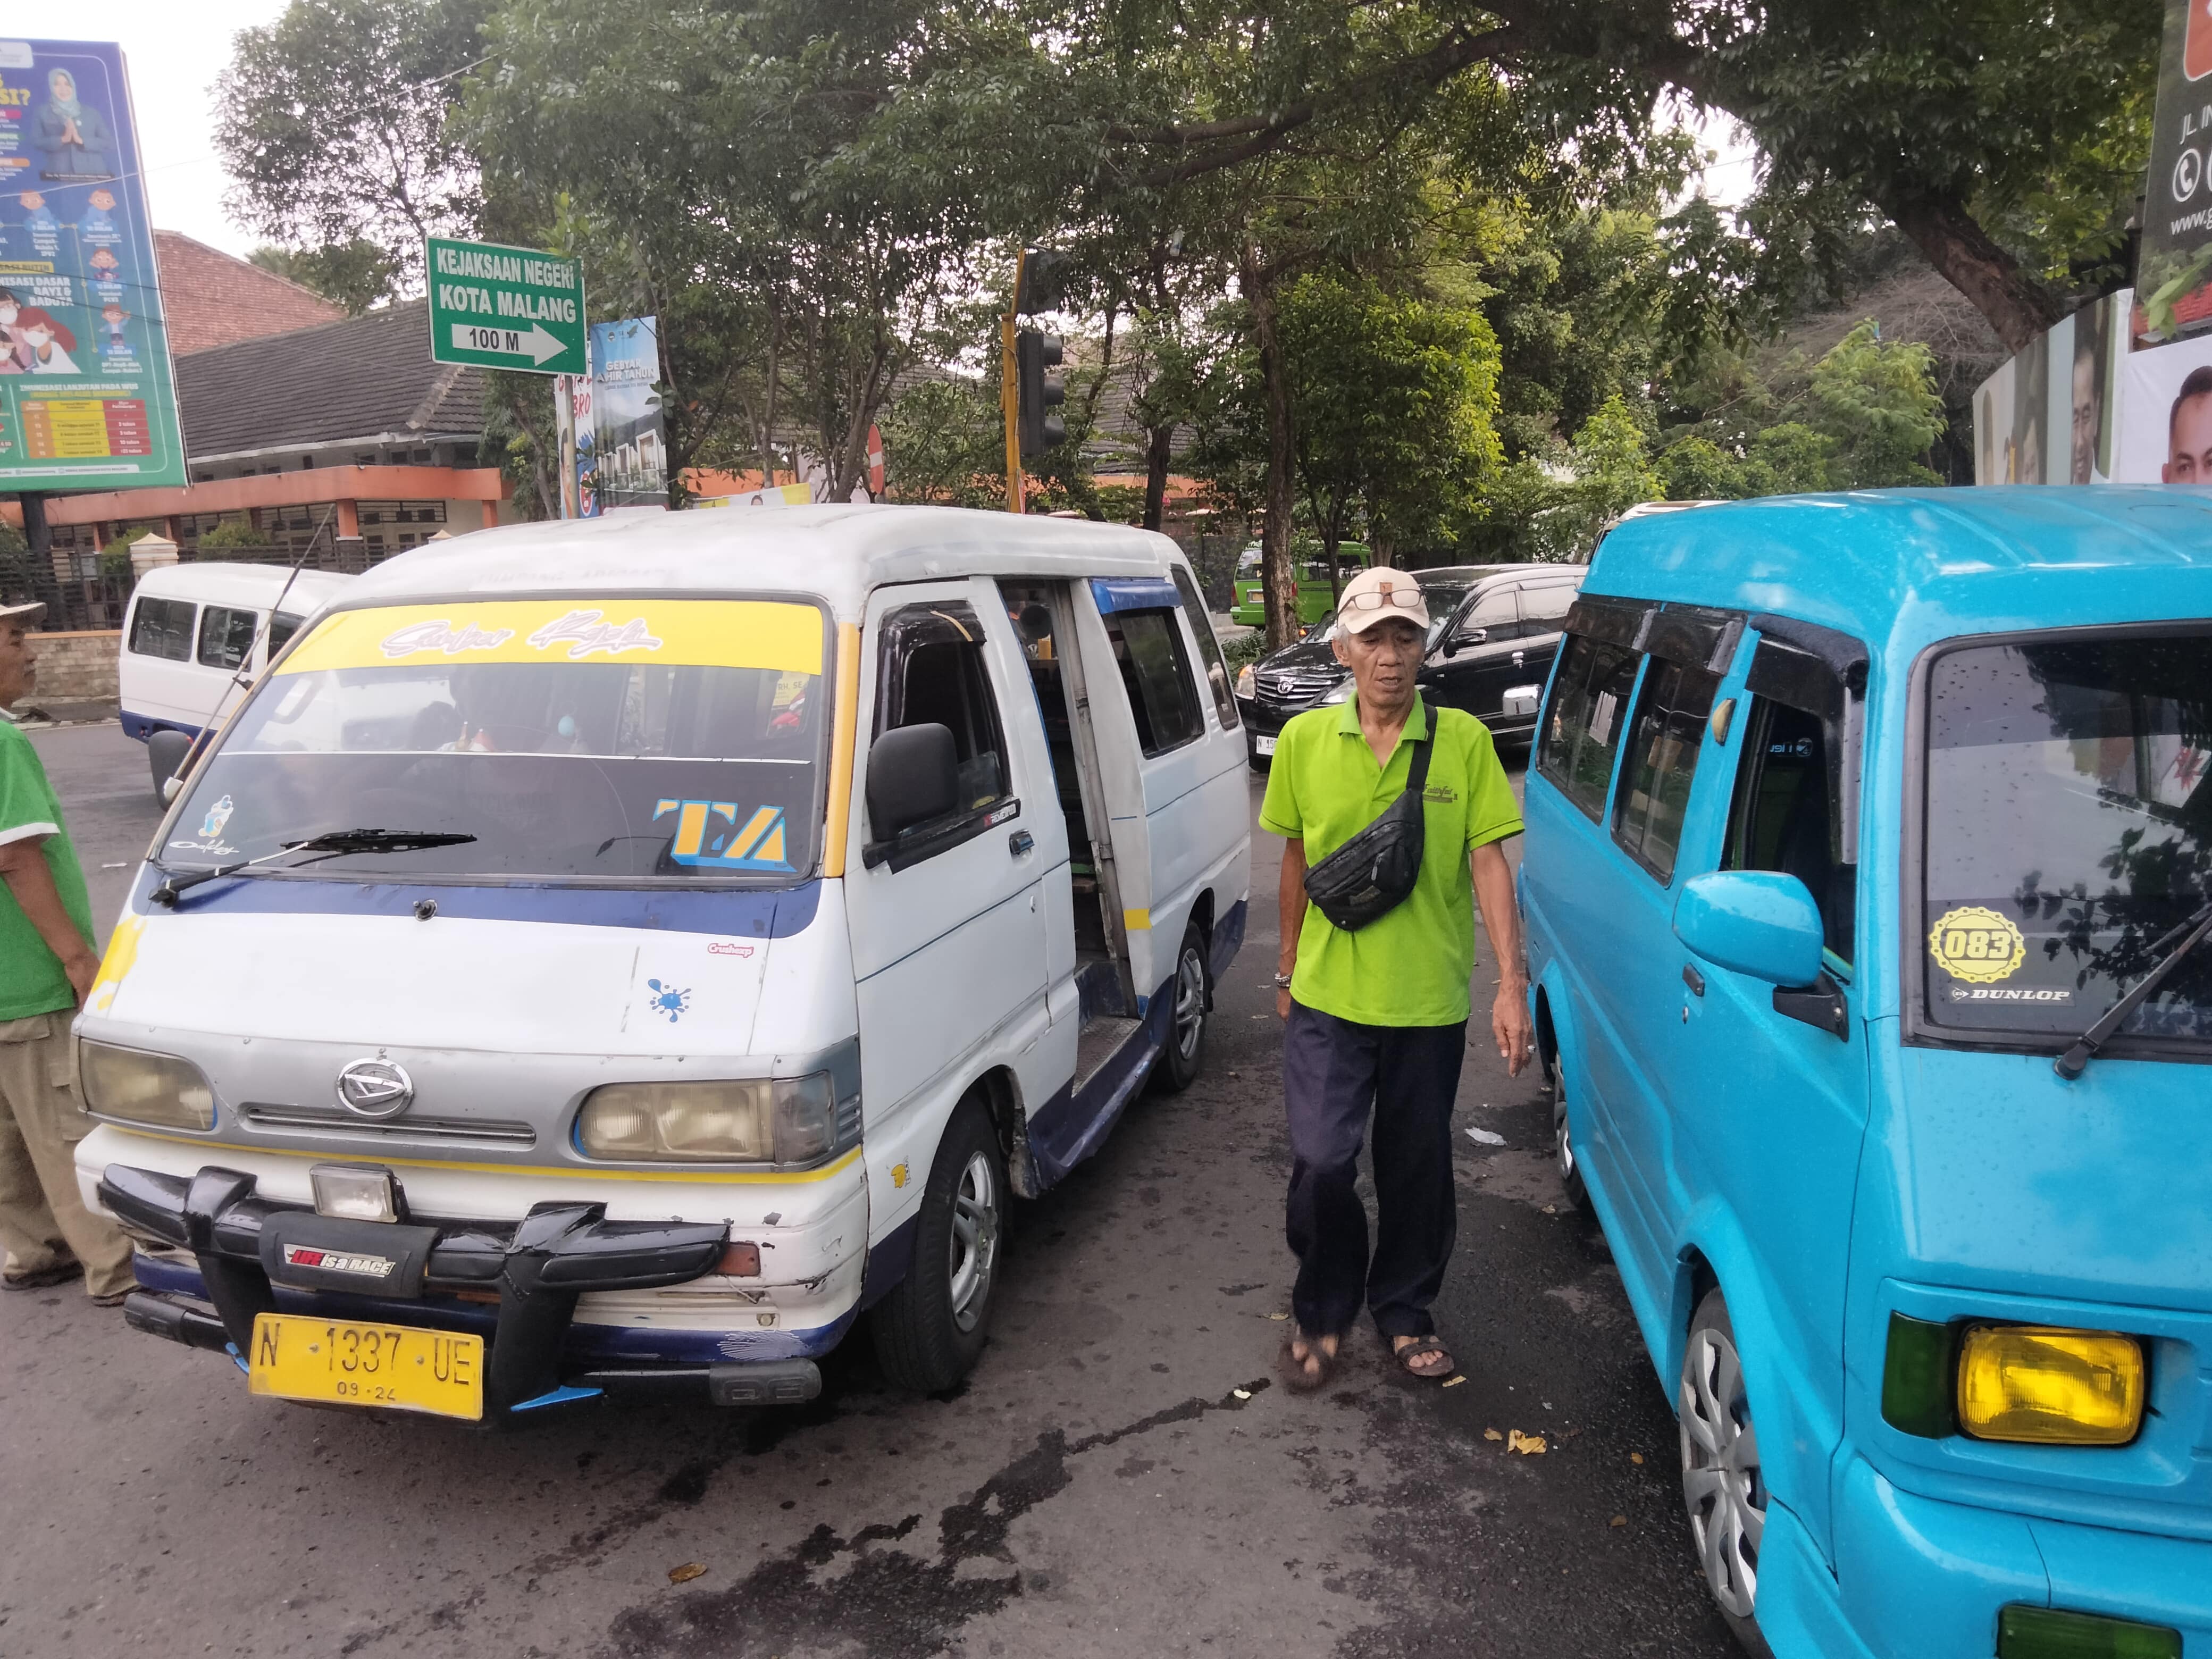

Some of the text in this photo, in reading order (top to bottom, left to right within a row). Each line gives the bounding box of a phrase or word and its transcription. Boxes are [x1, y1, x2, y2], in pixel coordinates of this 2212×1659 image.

[437, 247, 574, 289] KEJAKSAAN NEGERI
[36, 277, 71, 286] DASAR
[439, 283, 576, 323] KOTA MALANG
[469, 328, 519, 351] 100 M
[574, 393, 591, 418] BRO
[1258, 738, 1262, 748] N
[169, 840, 240, 855] Oakley
[1945, 931, 2012, 958] 083
[1970, 989, 2070, 1001] DUNLOP
[348, 1259, 392, 1273] RACE
[259, 1322, 471, 1386] N 1337 UE
